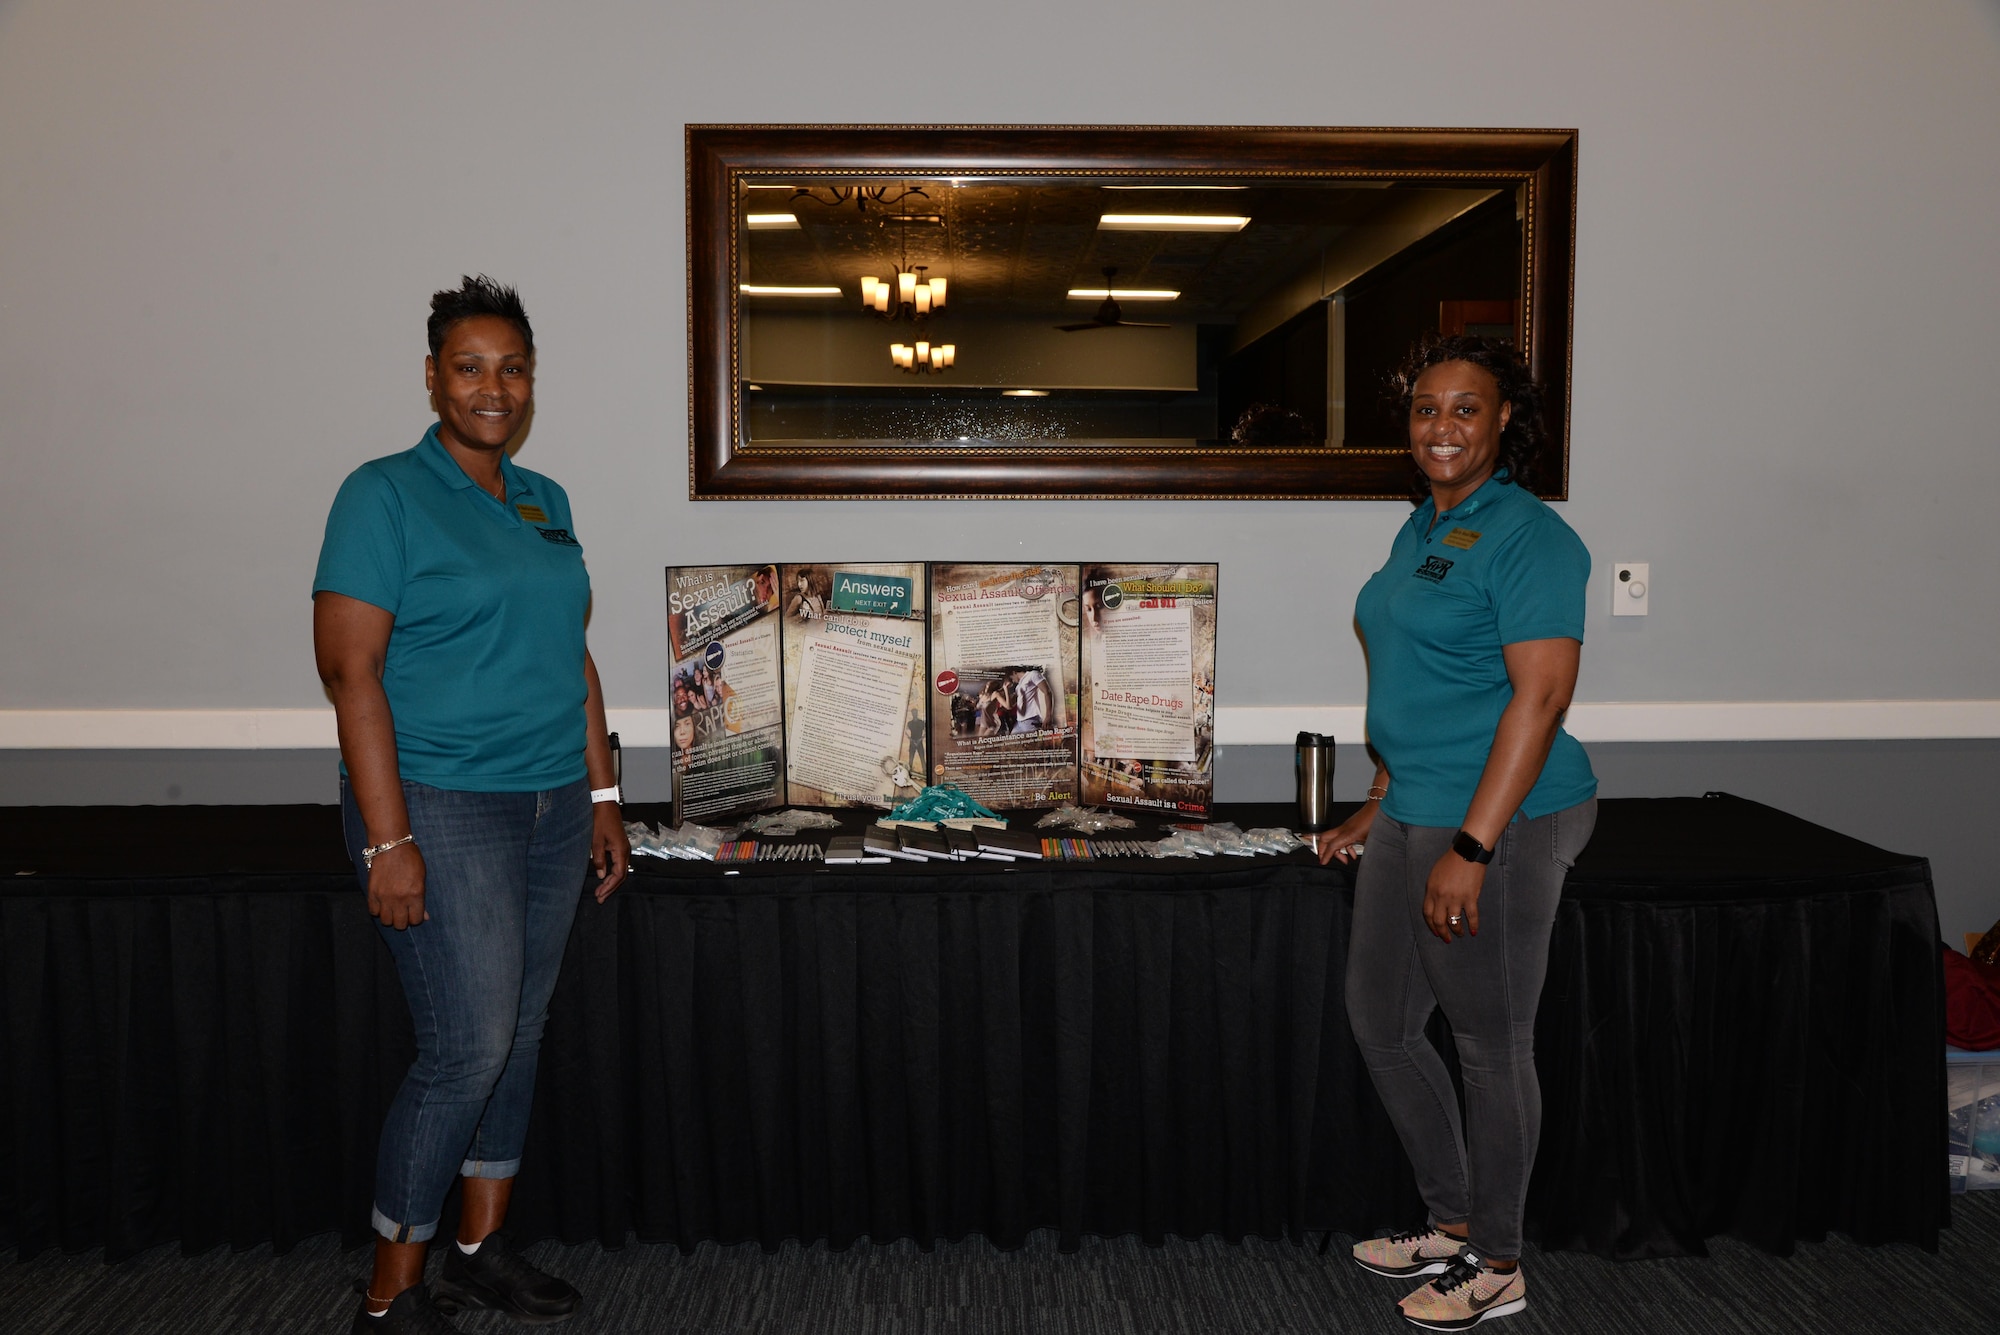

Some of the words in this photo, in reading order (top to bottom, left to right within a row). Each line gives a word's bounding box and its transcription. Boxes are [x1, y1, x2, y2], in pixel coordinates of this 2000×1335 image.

[676, 574, 703, 589] What
[705, 572, 714, 582] is
[840, 578, 905, 598] Answers
[1123, 582, 1145, 592] What
[1147, 583, 1176, 592] Should
[1178, 584, 1181, 592] I
[1185, 584, 1203, 592] Do?
[670, 575, 732, 615] Sexual
[938, 590, 977, 602] Sexual
[980, 587, 1021, 600] Assault
[1025, 584, 1076, 596] Offender
[685, 578, 756, 637] Assault?
[1139, 598, 1159, 608] call
[1160, 598, 1176, 608] 911
[799, 609, 821, 620] What
[824, 614, 839, 622] can
[847, 616, 858, 626] do
[825, 621, 868, 639] protect
[870, 632, 912, 648] myself
[815, 642, 832, 650] Sexual
[833, 646, 852, 654] Assault
[857, 639, 872, 648] from
[873, 642, 894, 653] sexual
[895, 647, 922, 660] assault?
[1101, 690, 1123, 702] Date
[1125, 692, 1149, 706] Rape
[1152, 695, 1183, 710] Drugs
[978, 732, 1024, 745] Acquaintance
[1038, 728, 1053, 736] Date
[1054, 726, 1073, 735] Rape?
[688, 759, 706, 769] victim
[707, 755, 721, 764] does
[838, 792, 860, 802] Trust
[861, 795, 880, 803] your
[1048, 792, 1073, 800] Alert.
[1107, 793, 1132, 804] Sexual
[1134, 796, 1162, 808] Assault
[1178, 801, 1207, 812] Crime.
